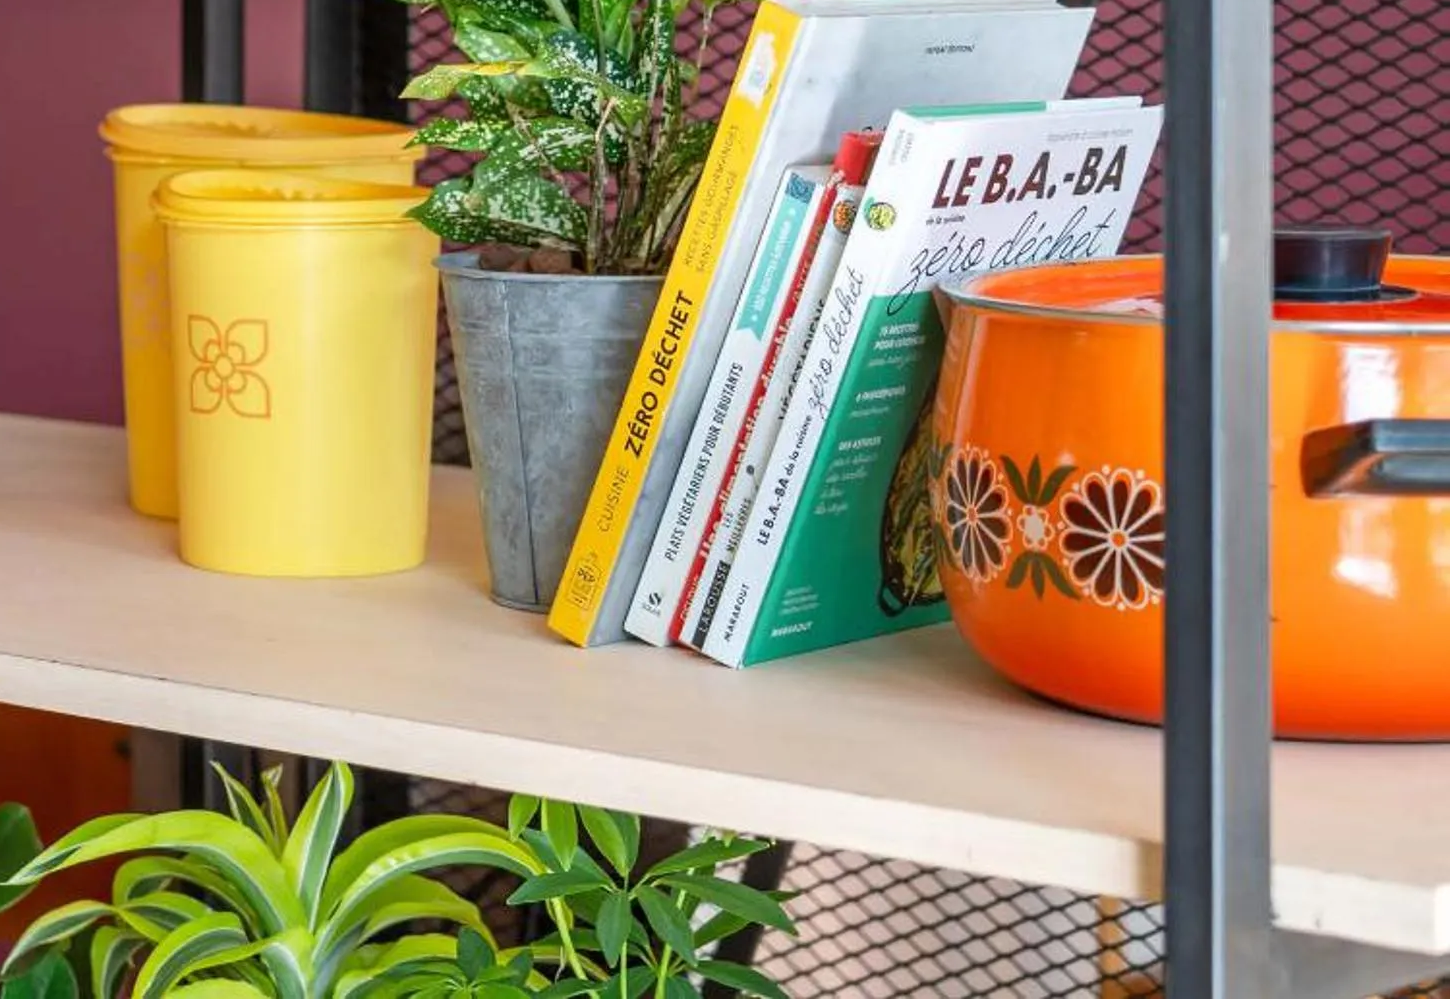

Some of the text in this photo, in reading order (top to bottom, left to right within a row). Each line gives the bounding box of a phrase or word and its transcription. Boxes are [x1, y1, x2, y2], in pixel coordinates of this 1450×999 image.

[931, 156, 983, 209] LE
[981, 145, 1129, 205] B.A.-BA
[887, 231, 985, 316] zéro
[990, 205, 1117, 270] déchet
[599, 290, 693, 533] CUISINE ZÉRO DÉCHET
[757, 528, 772, 546] LE
[807, 358, 833, 422] zéro
[826, 264, 867, 355] déchet
[664, 362, 743, 561] PLATS VÉGÉTARIENS POUR DÉBUTANTS
[700, 561, 730, 633] LAROUSSE
[723, 583, 750, 642] MARABOUT
